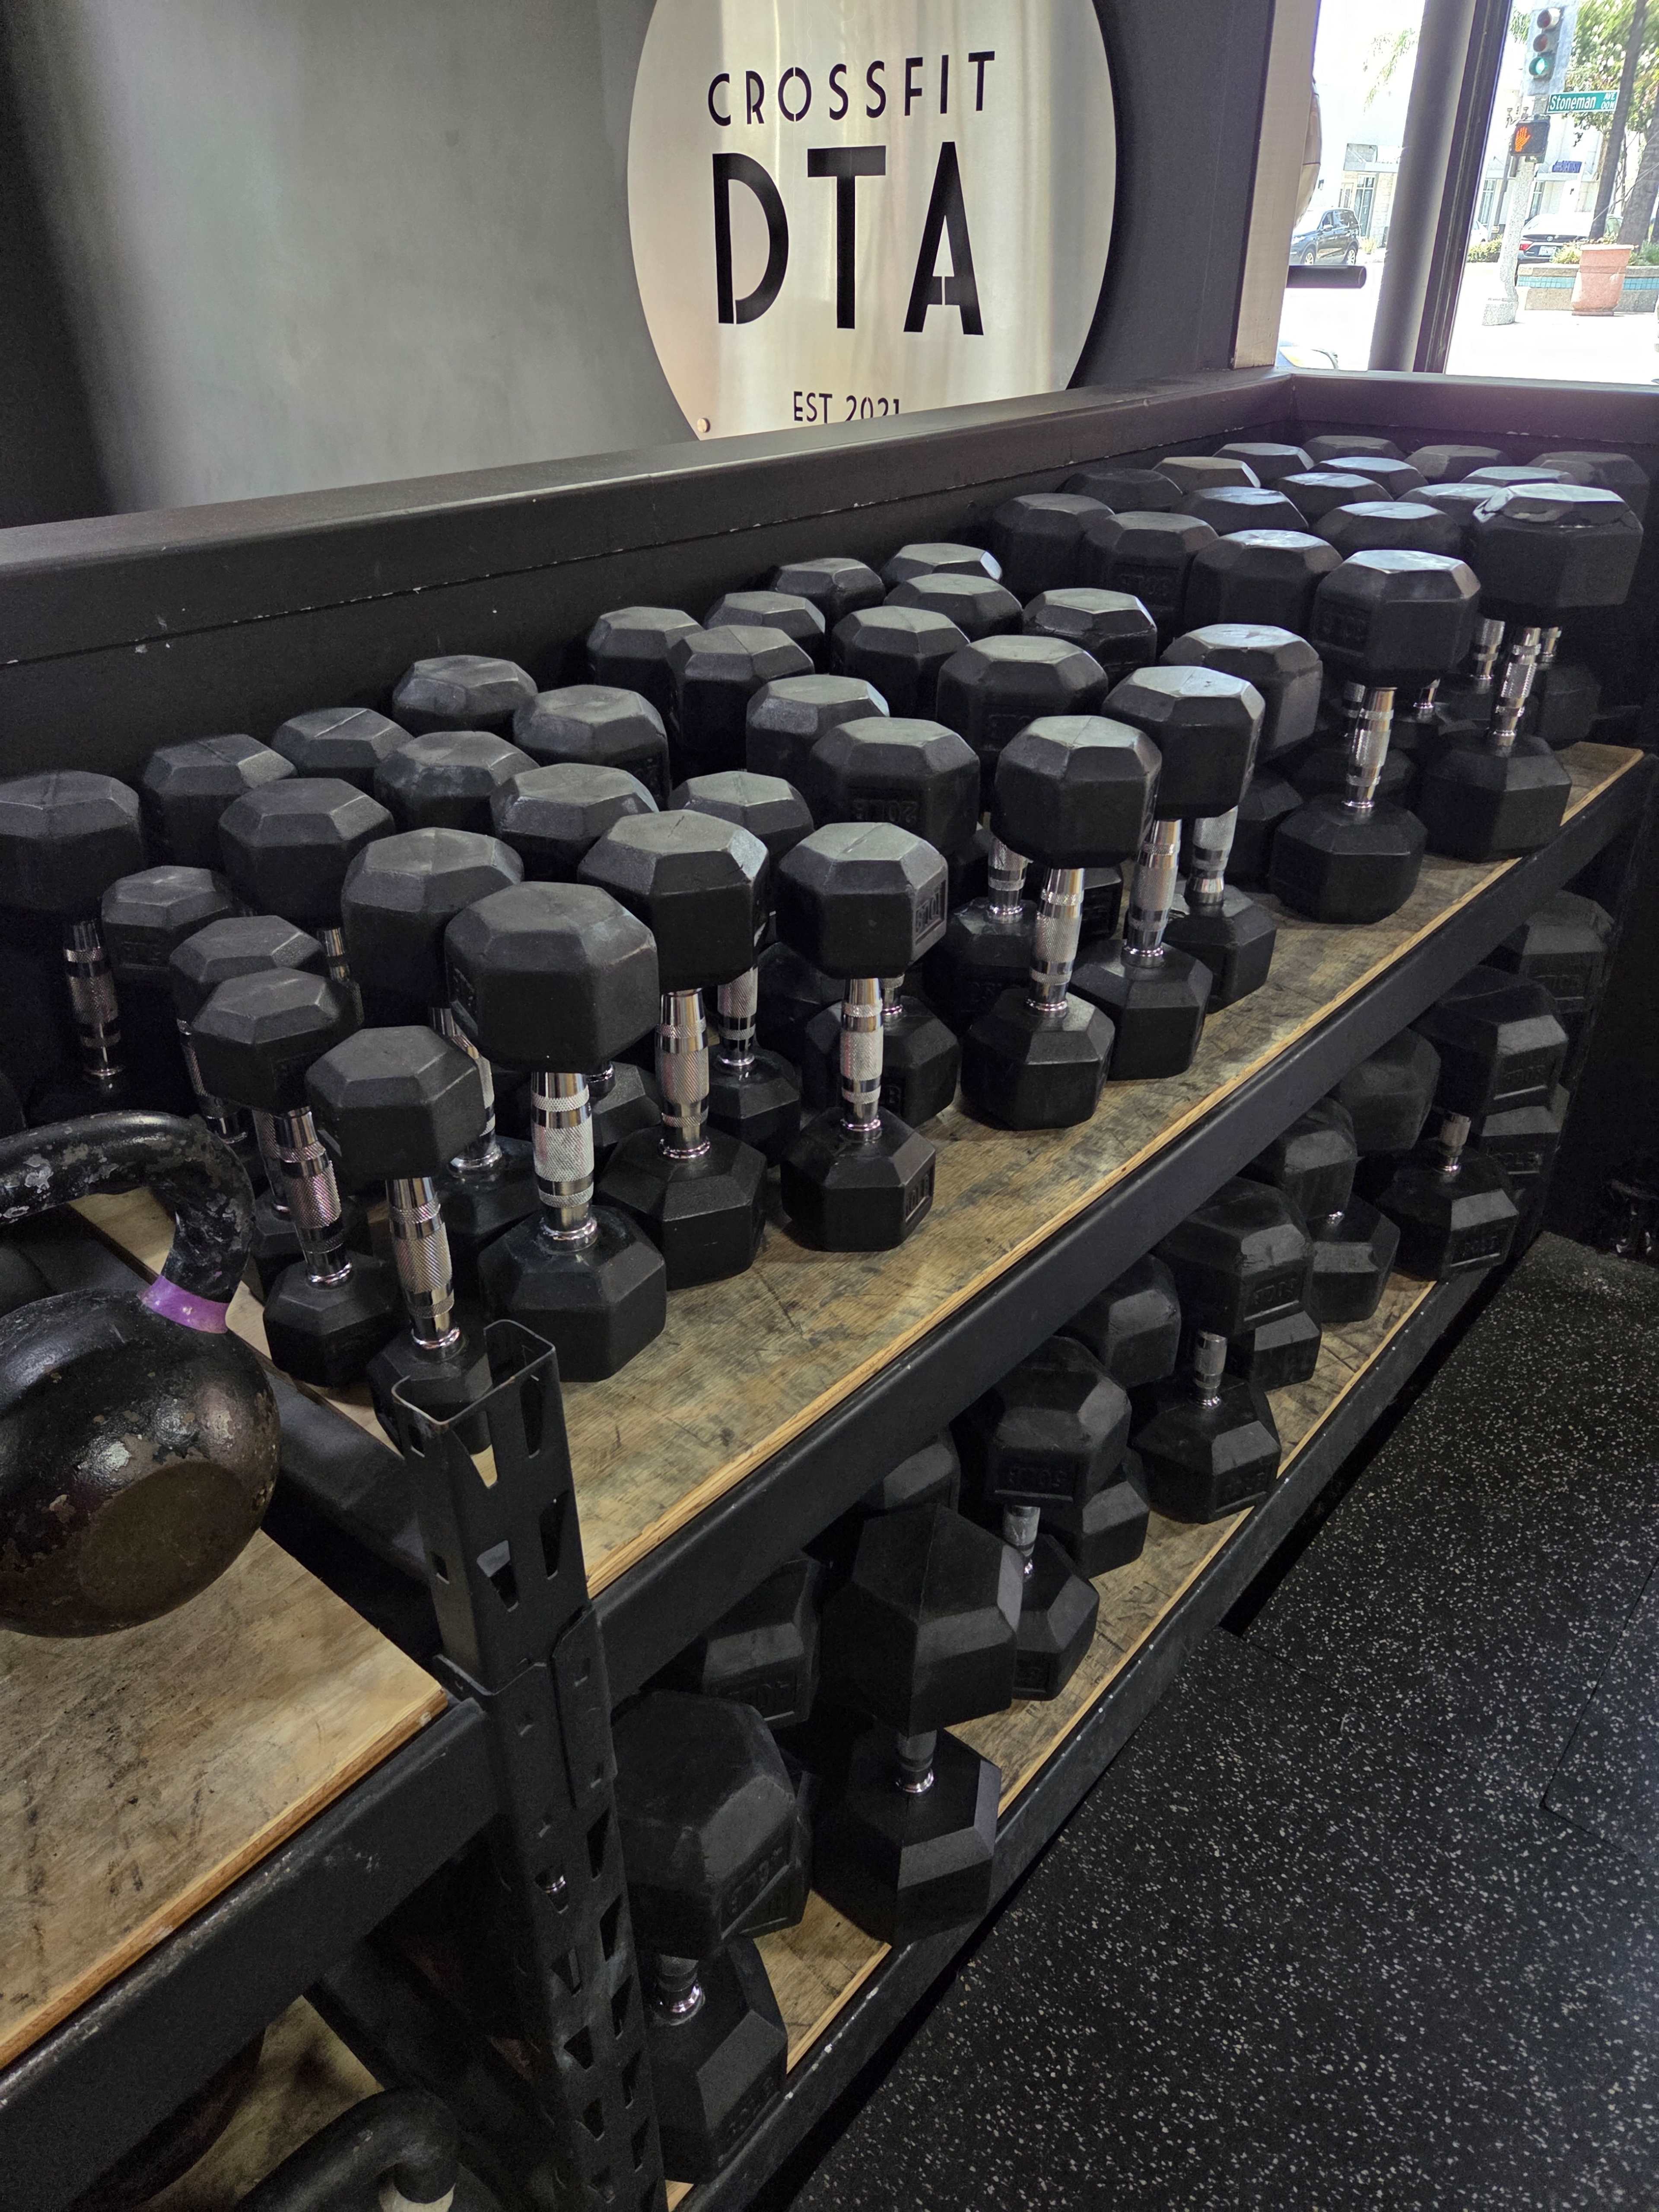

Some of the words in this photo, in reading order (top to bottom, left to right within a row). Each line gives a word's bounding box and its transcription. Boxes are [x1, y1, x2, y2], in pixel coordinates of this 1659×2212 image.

[708, 51, 995, 126] CROSSFIT
[1550, 95, 1596, 110] Stoneman
[1603, 92, 1616, 101] AVE
[712, 141, 984, 336] DTA
[793, 391, 833, 424] EST
